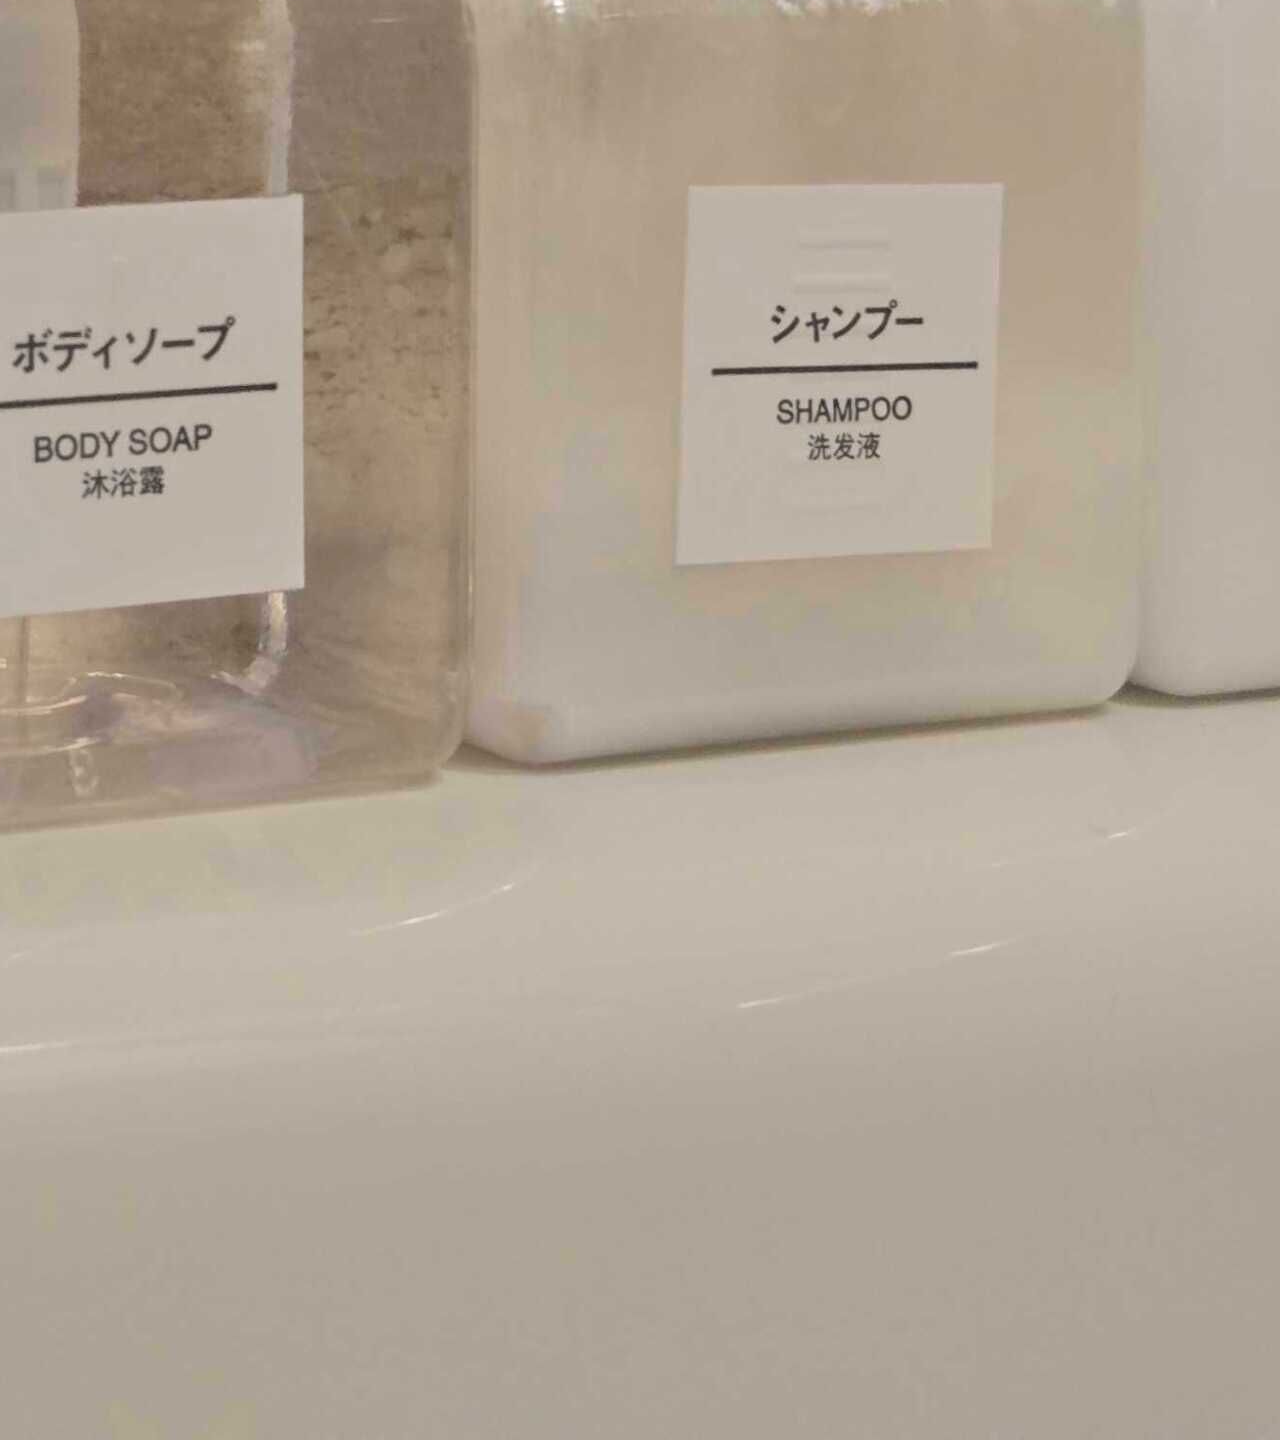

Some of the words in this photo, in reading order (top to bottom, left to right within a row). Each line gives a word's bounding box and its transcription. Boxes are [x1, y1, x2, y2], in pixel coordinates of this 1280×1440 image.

[769, 297, 925, 345] シャンプー
[11, 315, 237, 375] ボディソープ
[775, 394, 914, 426] SHAMPOO
[32, 429, 121, 464] BODY
[127, 423, 214, 457] SOAP
[806, 431, 882, 462] 洗发液
[81, 464, 167, 500] 沐浴露
